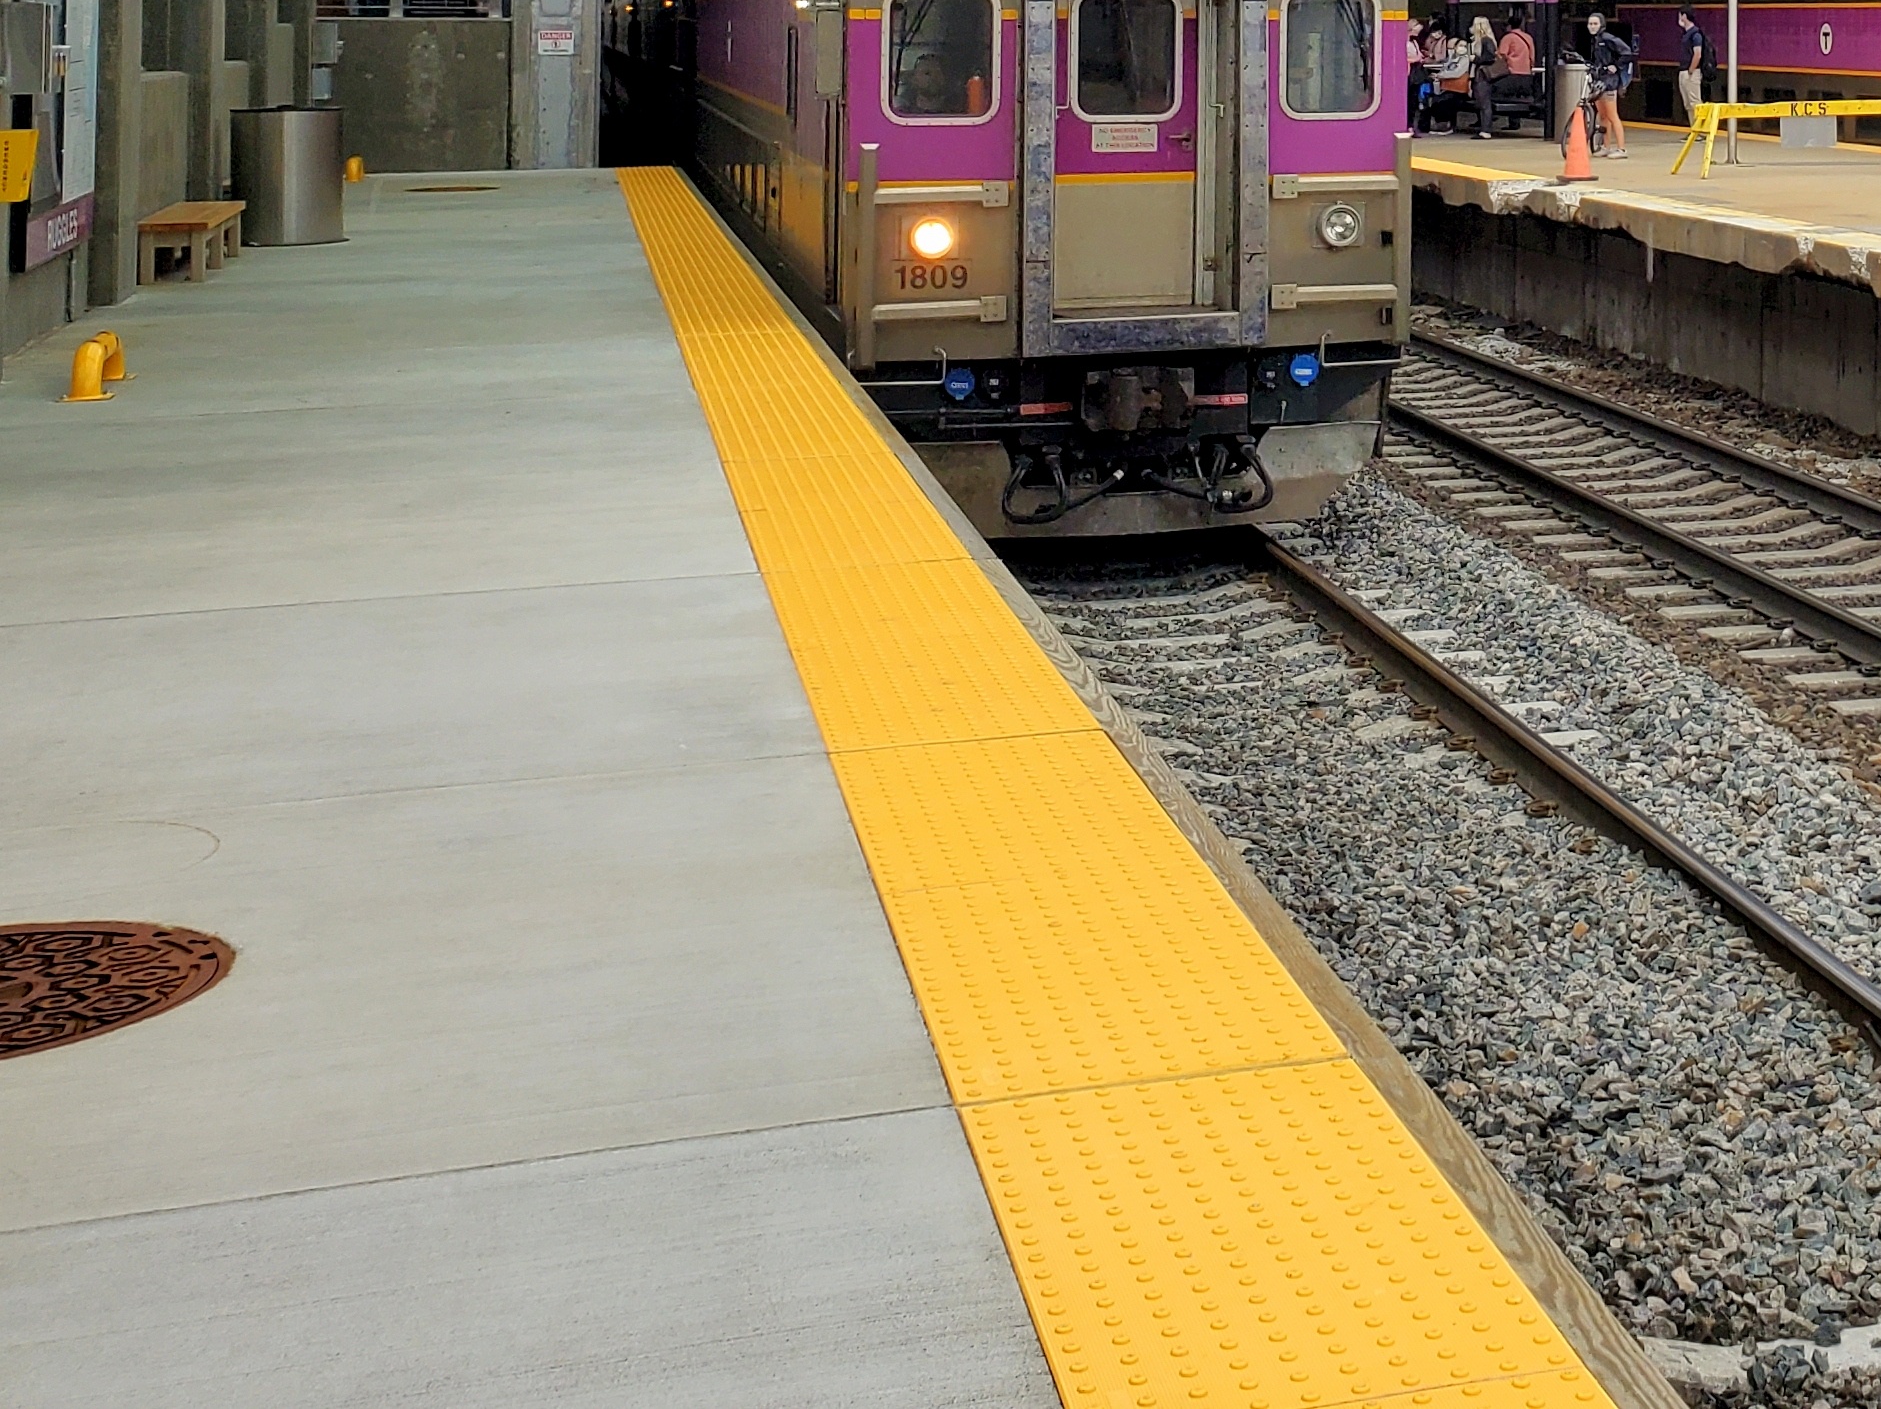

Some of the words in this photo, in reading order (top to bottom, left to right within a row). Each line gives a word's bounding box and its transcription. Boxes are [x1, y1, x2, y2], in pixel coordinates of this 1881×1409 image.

[541, 32, 571, 40] DANGER
[1822, 31, 1830, 50] T
[47, 208, 78, 252] RUGGLES
[894, 264, 968, 290] 1809
